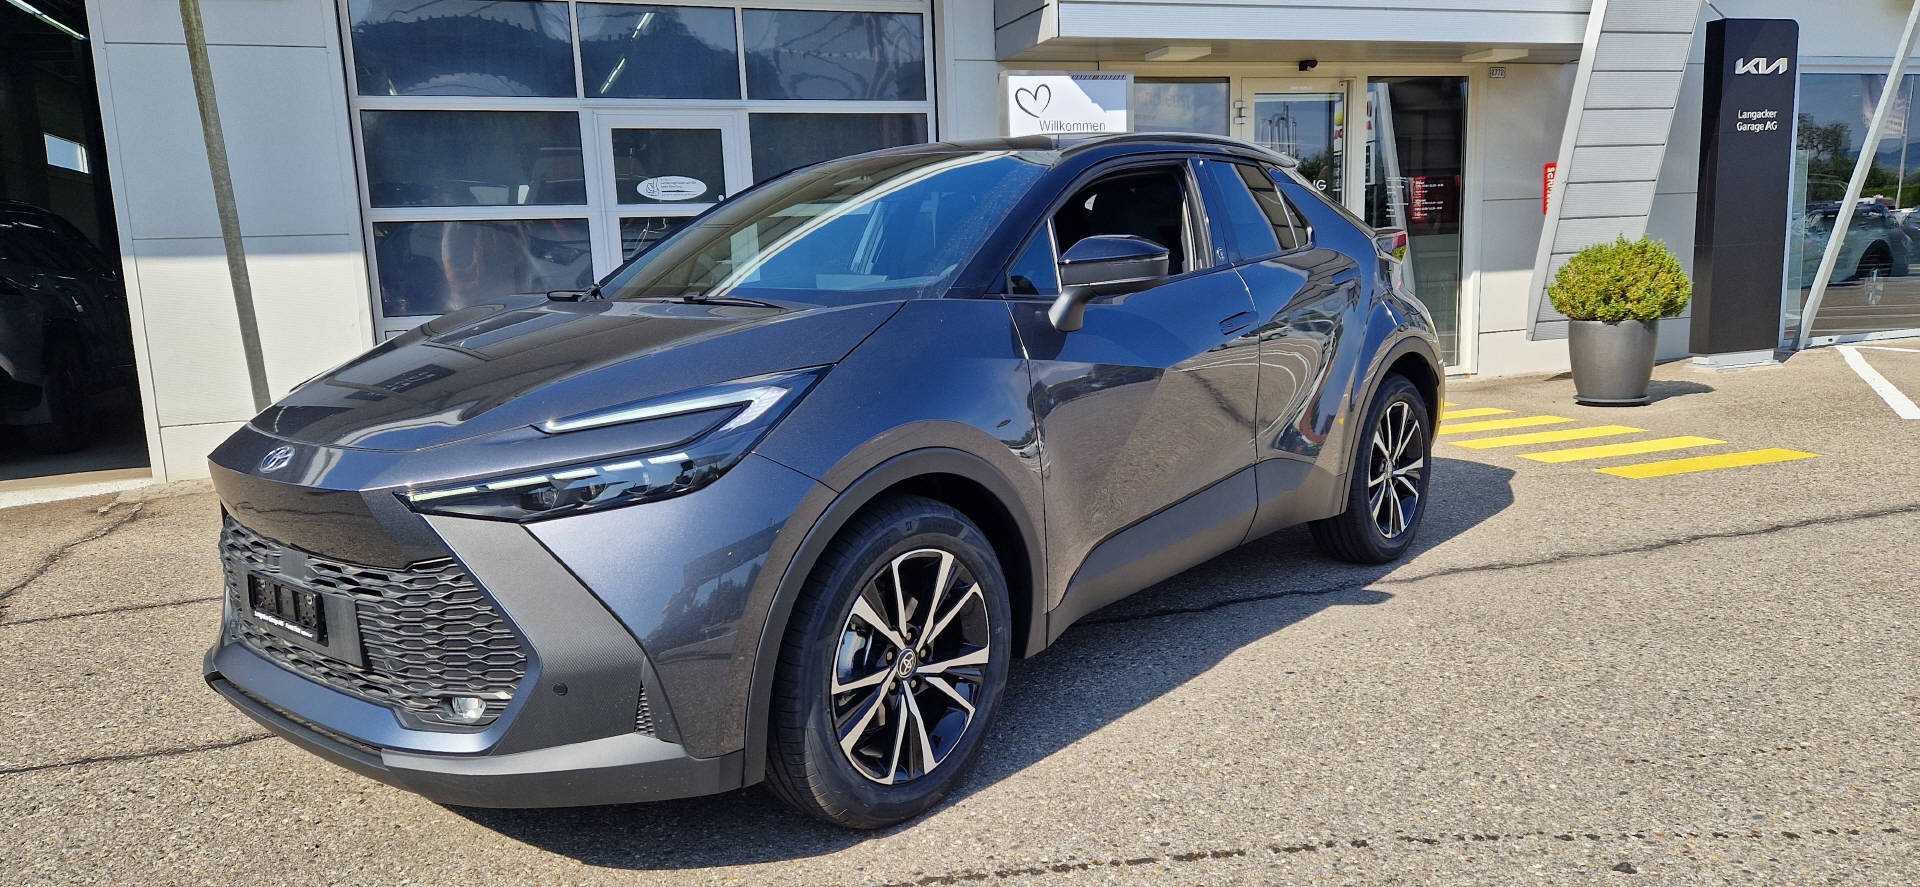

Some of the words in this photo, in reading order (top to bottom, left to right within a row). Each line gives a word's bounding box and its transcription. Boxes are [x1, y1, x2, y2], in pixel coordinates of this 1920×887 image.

[1735, 58, 1788, 75] KIA
[1738, 109, 1778, 121] Langacker
[1039, 119, 1106, 132] Willkommen
[1736, 121, 1765, 133] Garage
[1765, 120, 1778, 131] AG
